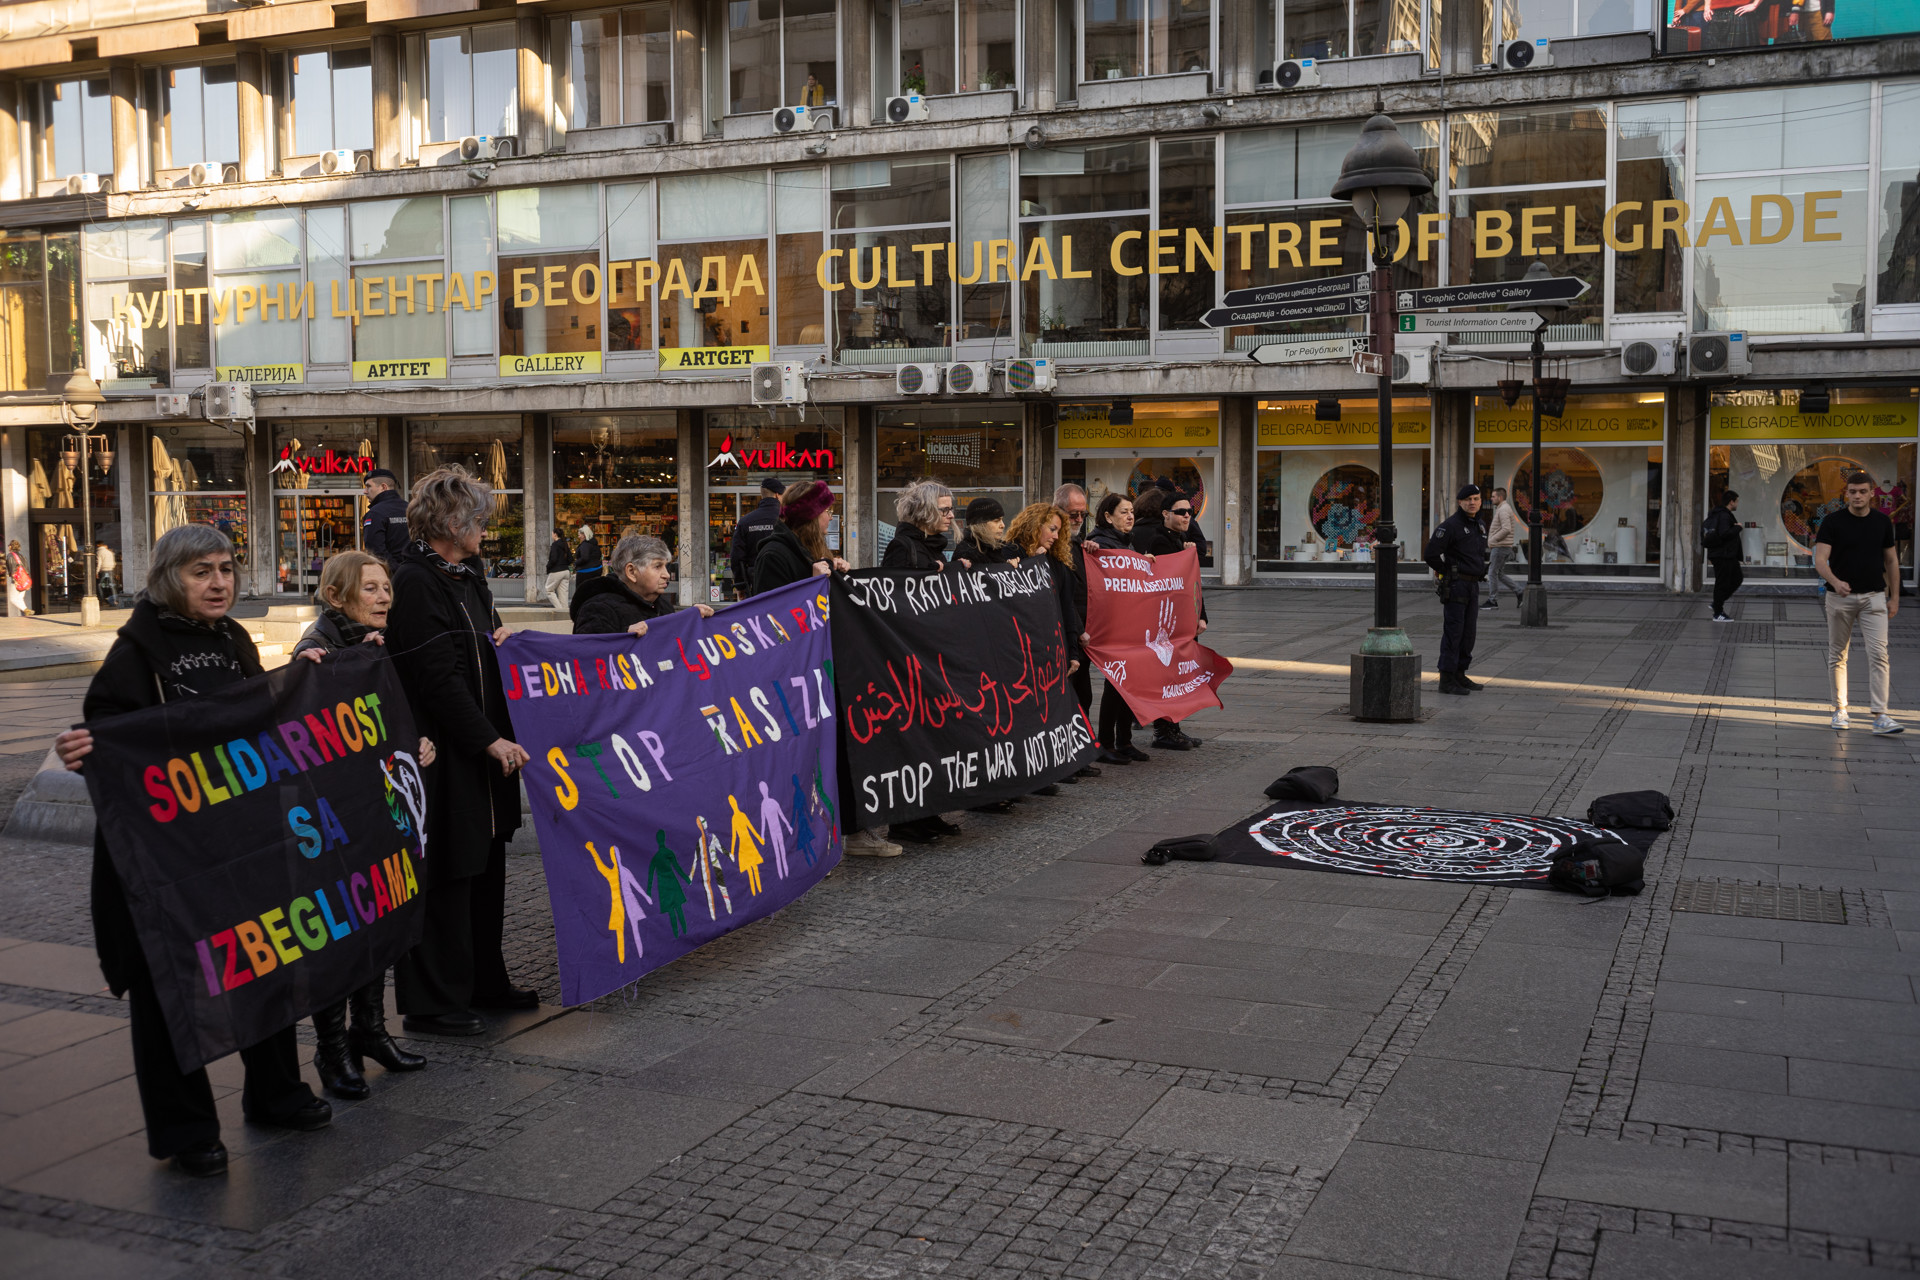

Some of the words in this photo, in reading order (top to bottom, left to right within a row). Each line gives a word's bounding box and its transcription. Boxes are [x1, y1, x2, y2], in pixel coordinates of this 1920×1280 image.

[816, 235, 1092, 292] CULTURAL
[1110, 218, 1343, 276] CENTRE
[1367, 213, 1450, 264] OF
[1474, 190, 1843, 259] BELGRADE
[112, 281, 316, 329] КУЛТУРНИ
[331, 270, 497, 325] ЦЕНТАР
[513, 253, 766, 309] БЕОГРАДА
[1317, 281, 1350, 294] Београда
[1501, 287, 1532, 299] Gallery
[1230, 308, 1275, 321] Скадарлија
[1280, 306, 1313, 316] боемска
[1425, 317, 1452, 327] Tourist
[1453, 317, 1498, 327] Information
[1500, 317, 1527, 327] Centre
[514, 355, 585, 374] GALLERY
[679, 348, 754, 367] ARTGET
[228, 366, 296, 384] ГАЛЕРИЈА
[1261, 422, 1333, 436] BELGRADE
[1335, 421, 1395, 435] WINDO
[1477, 418, 1573, 433] BEOGRADSKI
[1576, 417, 1620, 432] IZLOG
[1720, 415, 1800, 429] BELGRADE
[1803, 414, 1870, 428] WINDOW
[1063, 427, 1137, 440] BEOGRADSKI
[1139, 426, 1173, 439] IZLOG
[739, 441, 835, 469] vulkan
[926, 442, 970, 456] tickets.rs
[296, 449, 374, 474] vulkan
[1099, 555, 1131, 569] STOP
[1103, 577, 1143, 592] PREMA
[596, 653, 654, 690] RASA
[790, 594, 830, 634] RAS
[143, 692, 388, 823] SOLIDARNOST
[547, 730, 673, 811] STOP
[862, 762, 933, 813] STOP
[985, 742, 1017, 782] WAR
[1024, 731, 1048, 778] NOT
[287, 796, 351, 859] SA
[195, 848, 419, 997] IZBEGLICAMA
